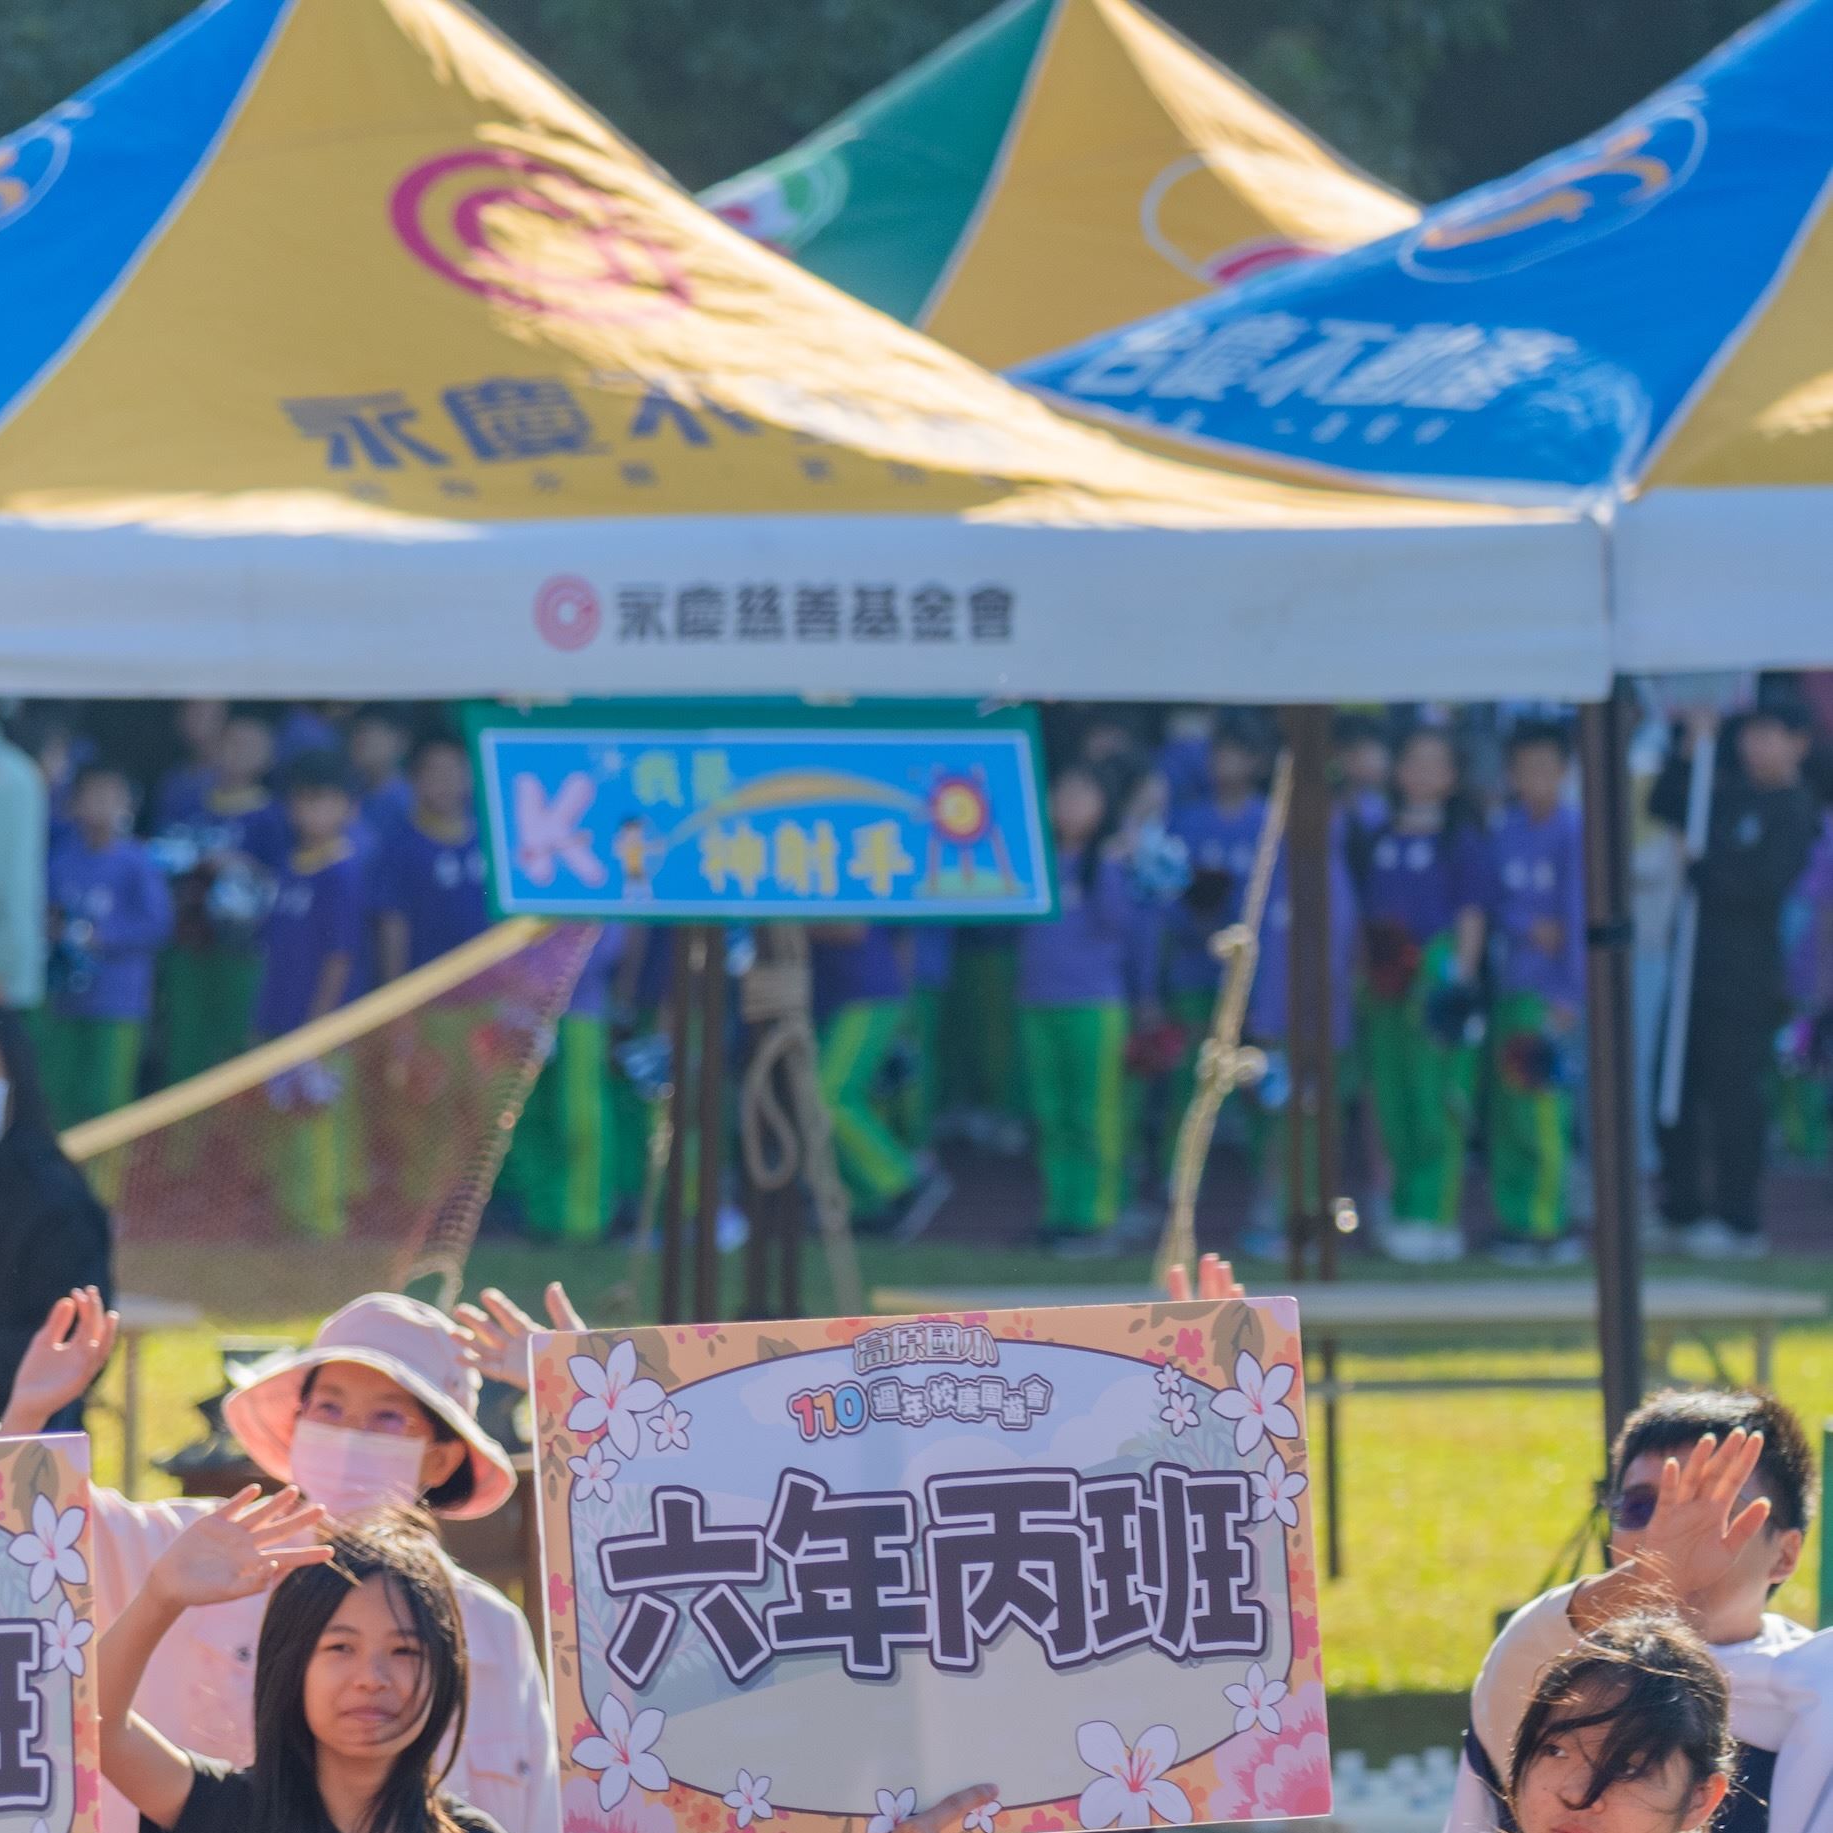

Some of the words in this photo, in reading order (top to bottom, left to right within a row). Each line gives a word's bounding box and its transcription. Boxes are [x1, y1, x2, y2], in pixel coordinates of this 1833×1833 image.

[615, 579, 1017, 644] 永慶慈善基金會
[513, 769, 610, 890] K
[854, 1321, 999, 1375] 高原國小
[598, 1466, 1268, 1687] 六年丙班
